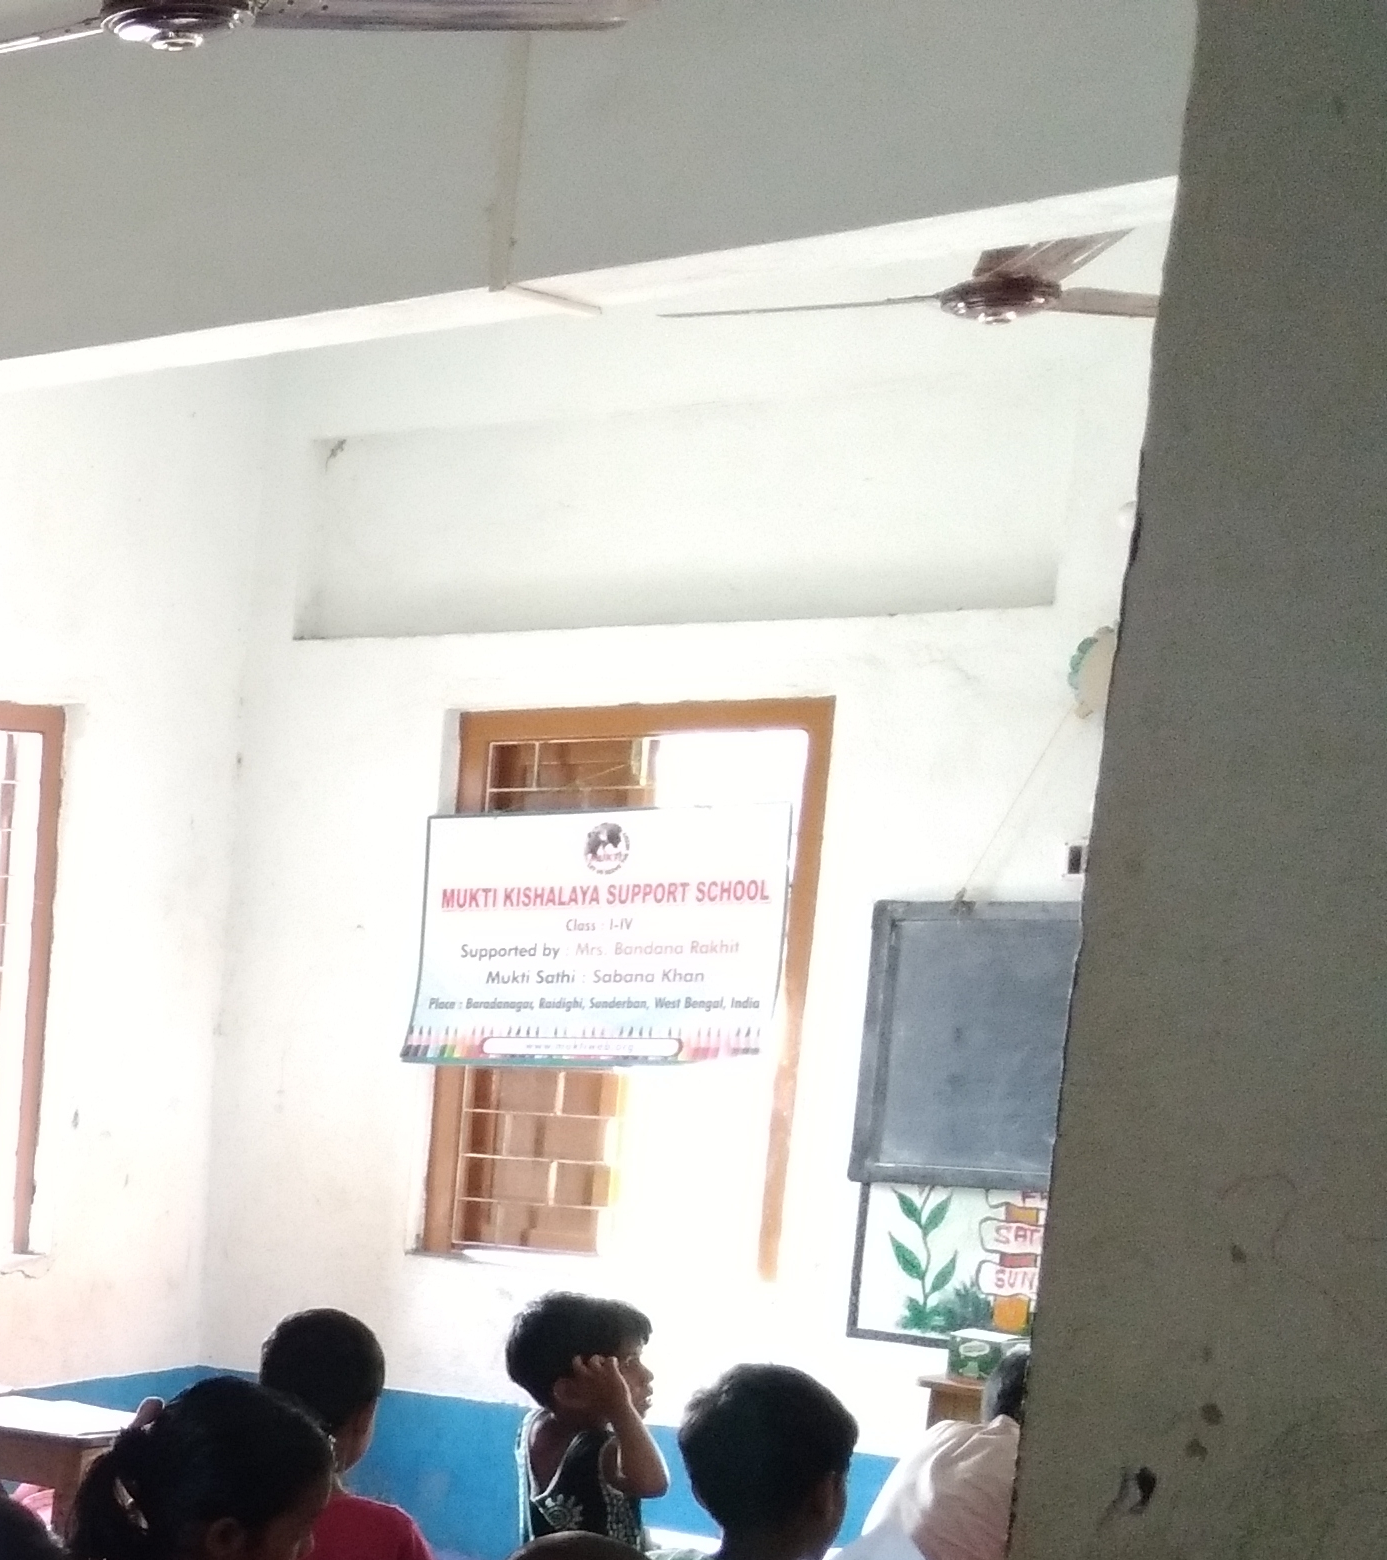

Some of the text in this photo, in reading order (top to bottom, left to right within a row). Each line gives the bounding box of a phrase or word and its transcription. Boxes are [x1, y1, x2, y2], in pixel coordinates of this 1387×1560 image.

[441, 880, 770, 909] MUKTI KISHALAYA SUPPORT SCHOOL
[565, 918, 596, 932] Class
[609, 918, 633, 931] I-IV
[460, 943, 538, 961] Supported
[542, 943, 561, 960] by
[576, 943, 608, 957] Mrs.
[614, 941, 684, 956] Bandana
[690, 939, 740, 954] Rakhit
[486, 970, 530, 984] Mukti
[536, 970, 576, 984] Sathi
[593, 969, 655, 984] Sabana
[661, 968, 705, 983] Khan
[428, 997, 456, 1010] Place
[465, 997, 534, 1013] Baradanagar,
[539, 997, 585, 1013] Raidighi,
[589, 997, 649, 1011] Sunderban,
[654, 997, 680, 1009] West
[684, 996, 726, 1012] Bengal,
[731, 997, 760, 1009] India
[995, 1225, 1041, 1244] SAT
[995, 1269, 1036, 1291] SUN
